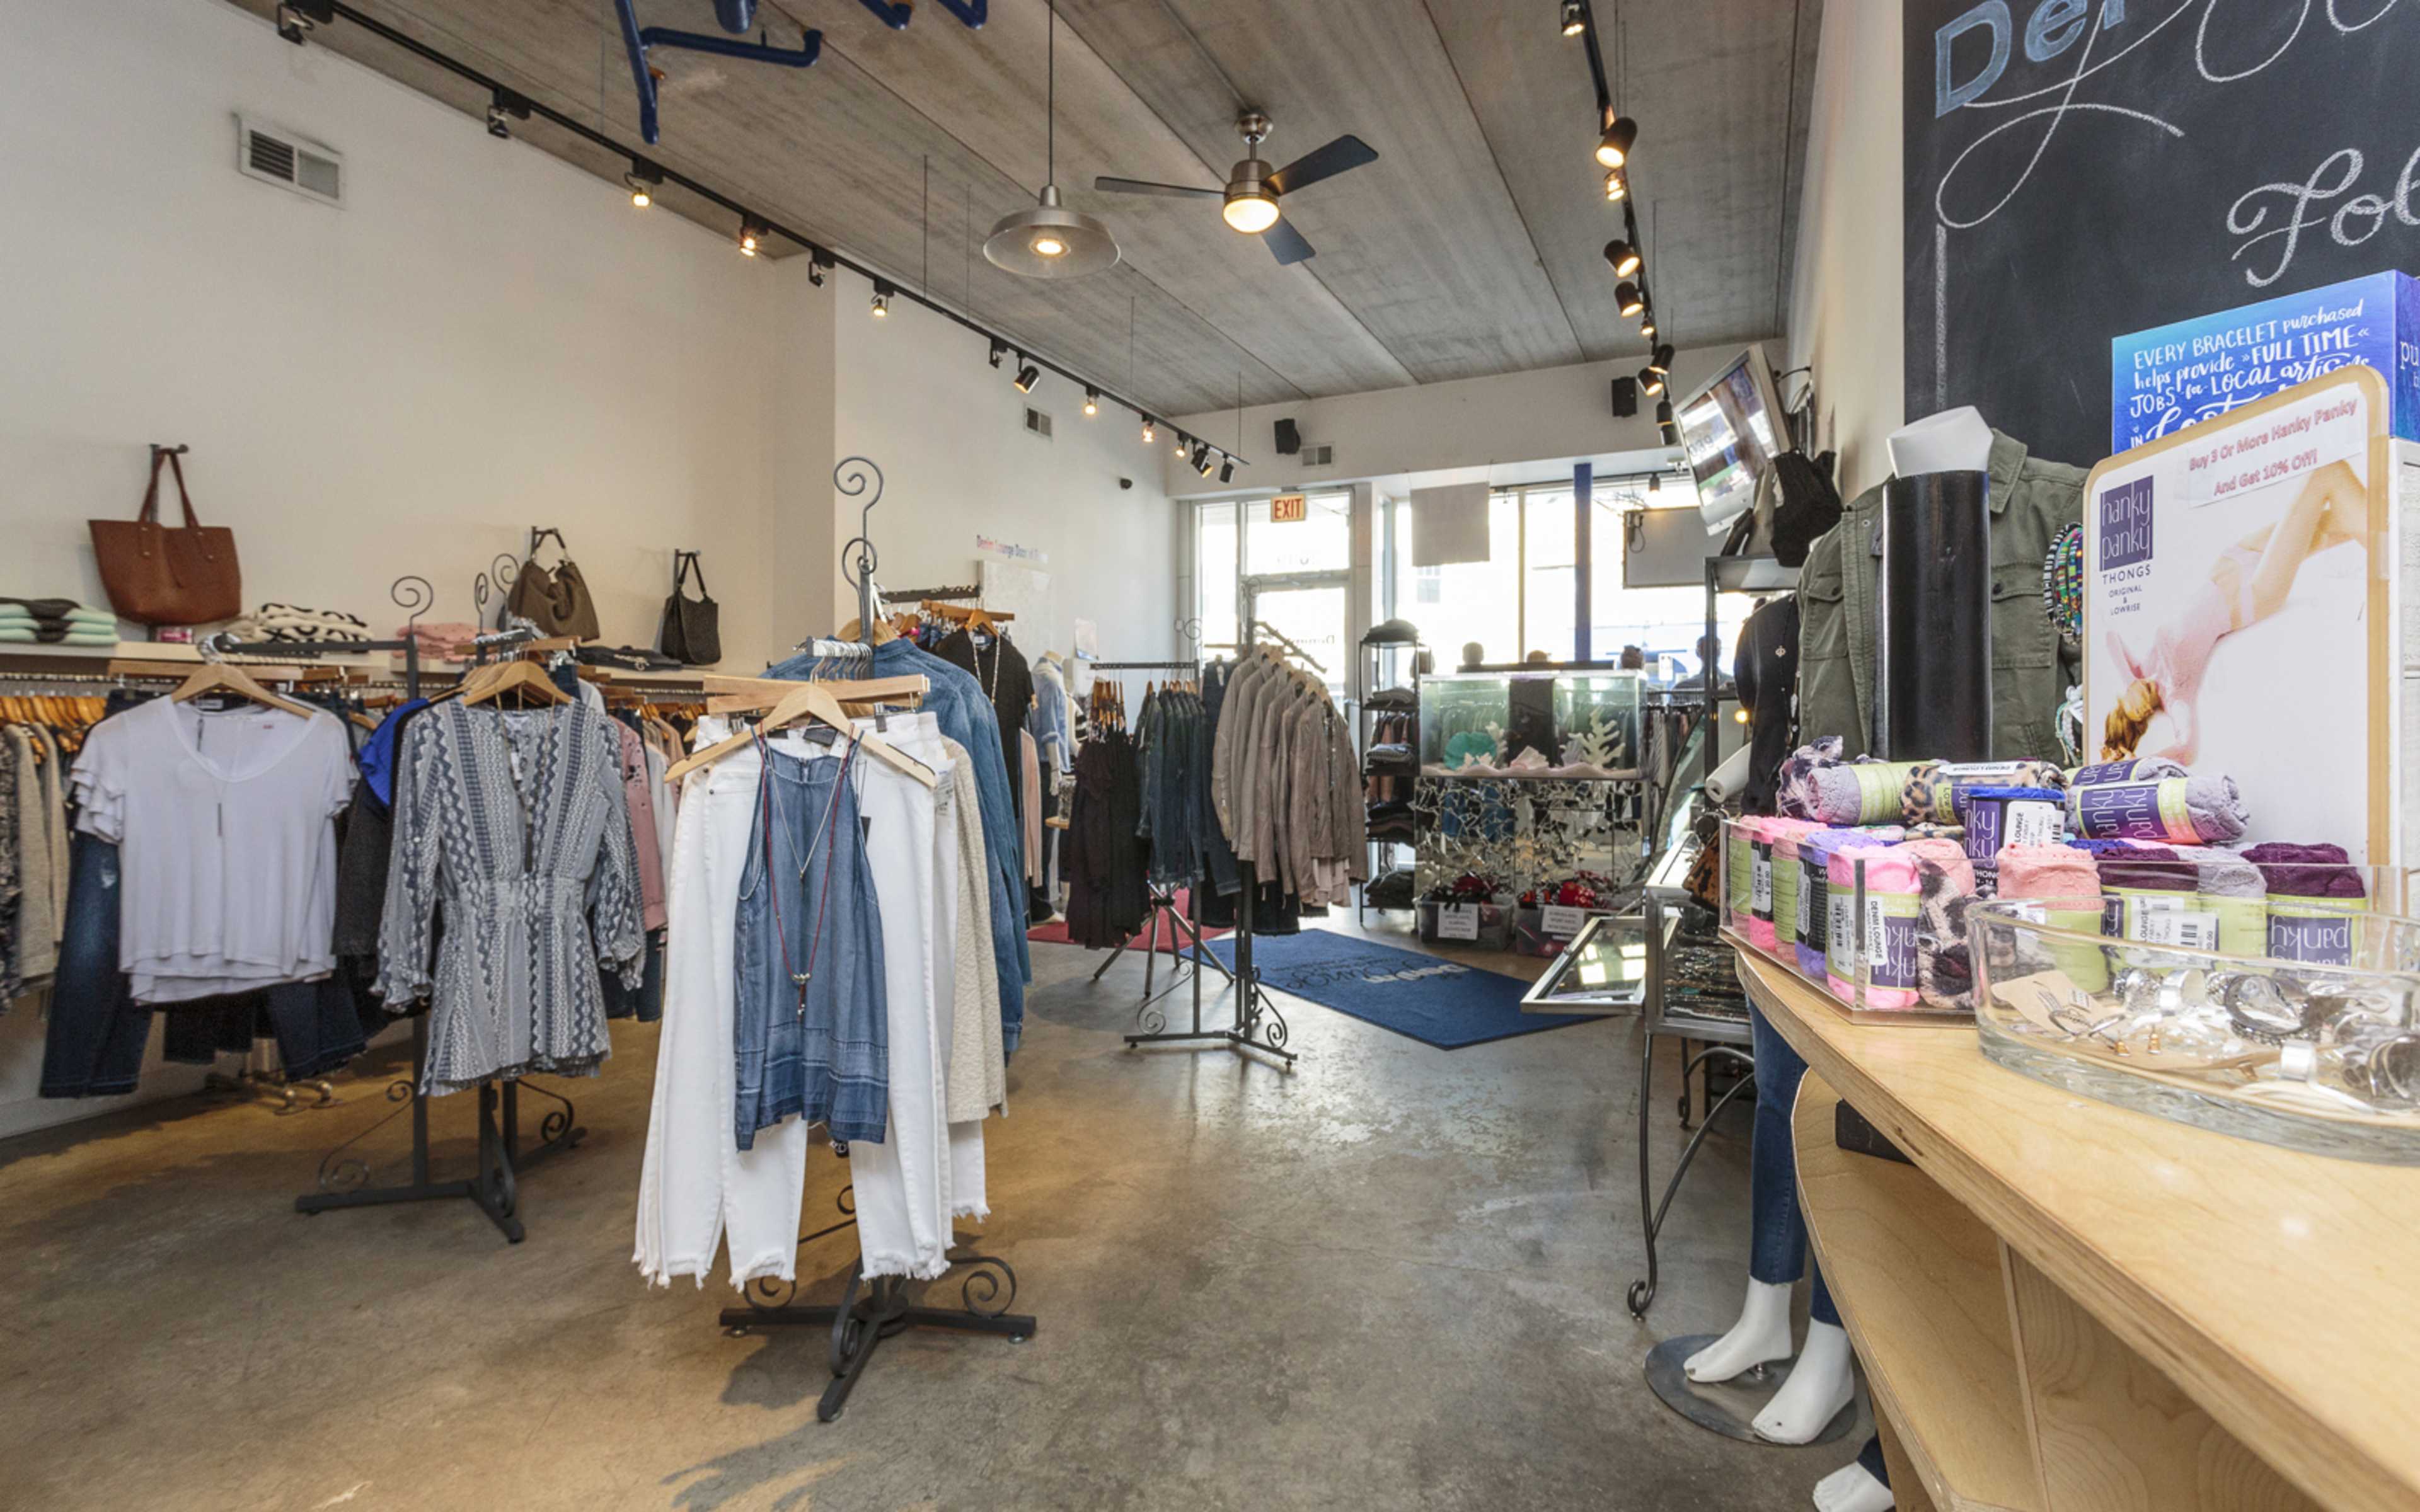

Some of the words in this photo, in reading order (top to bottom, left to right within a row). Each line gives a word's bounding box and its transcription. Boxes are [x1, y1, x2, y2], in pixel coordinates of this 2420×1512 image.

[2134, 341, 2187, 370] EVERY
[2192, 320, 2278, 357] BRACELET
[2283, 298, 2364, 335] purchased
[2134, 369, 2171, 393] helps
[2176, 352, 2235, 392] provide
[2130, 386, 2175, 418] JOBS
[2211, 364, 2278, 396] LOCAL
[2189, 453, 2209, 471] Buy
[2211, 449, 2218, 464] 3
[2220, 444, 2234, 461] Or
[2237, 432, 2269, 454] More
[2271, 414, 2312, 442] Hanky
[2314, 398, 2358, 426] Panky
[2214, 474, 2237, 496] And
[2239, 468, 2261, 488] Get
[2263, 458, 2290, 481] 10%
[1273, 498, 1303, 520] EXIT
[2102, 483, 2150, 527] hanky
[2102, 524, 2150, 571] panky
[2102, 564, 2151, 585] THONGS
[2109, 584, 2143, 598] ORIGINAL
[2110, 602, 2141, 616] LOWRISE
[2014, 812, 2024, 843] LOUNGE
[1870, 900, 1881, 927] DENIM
[1872, 926, 1884, 959] LOUNGE
[2271, 915, 2349, 950] panky
